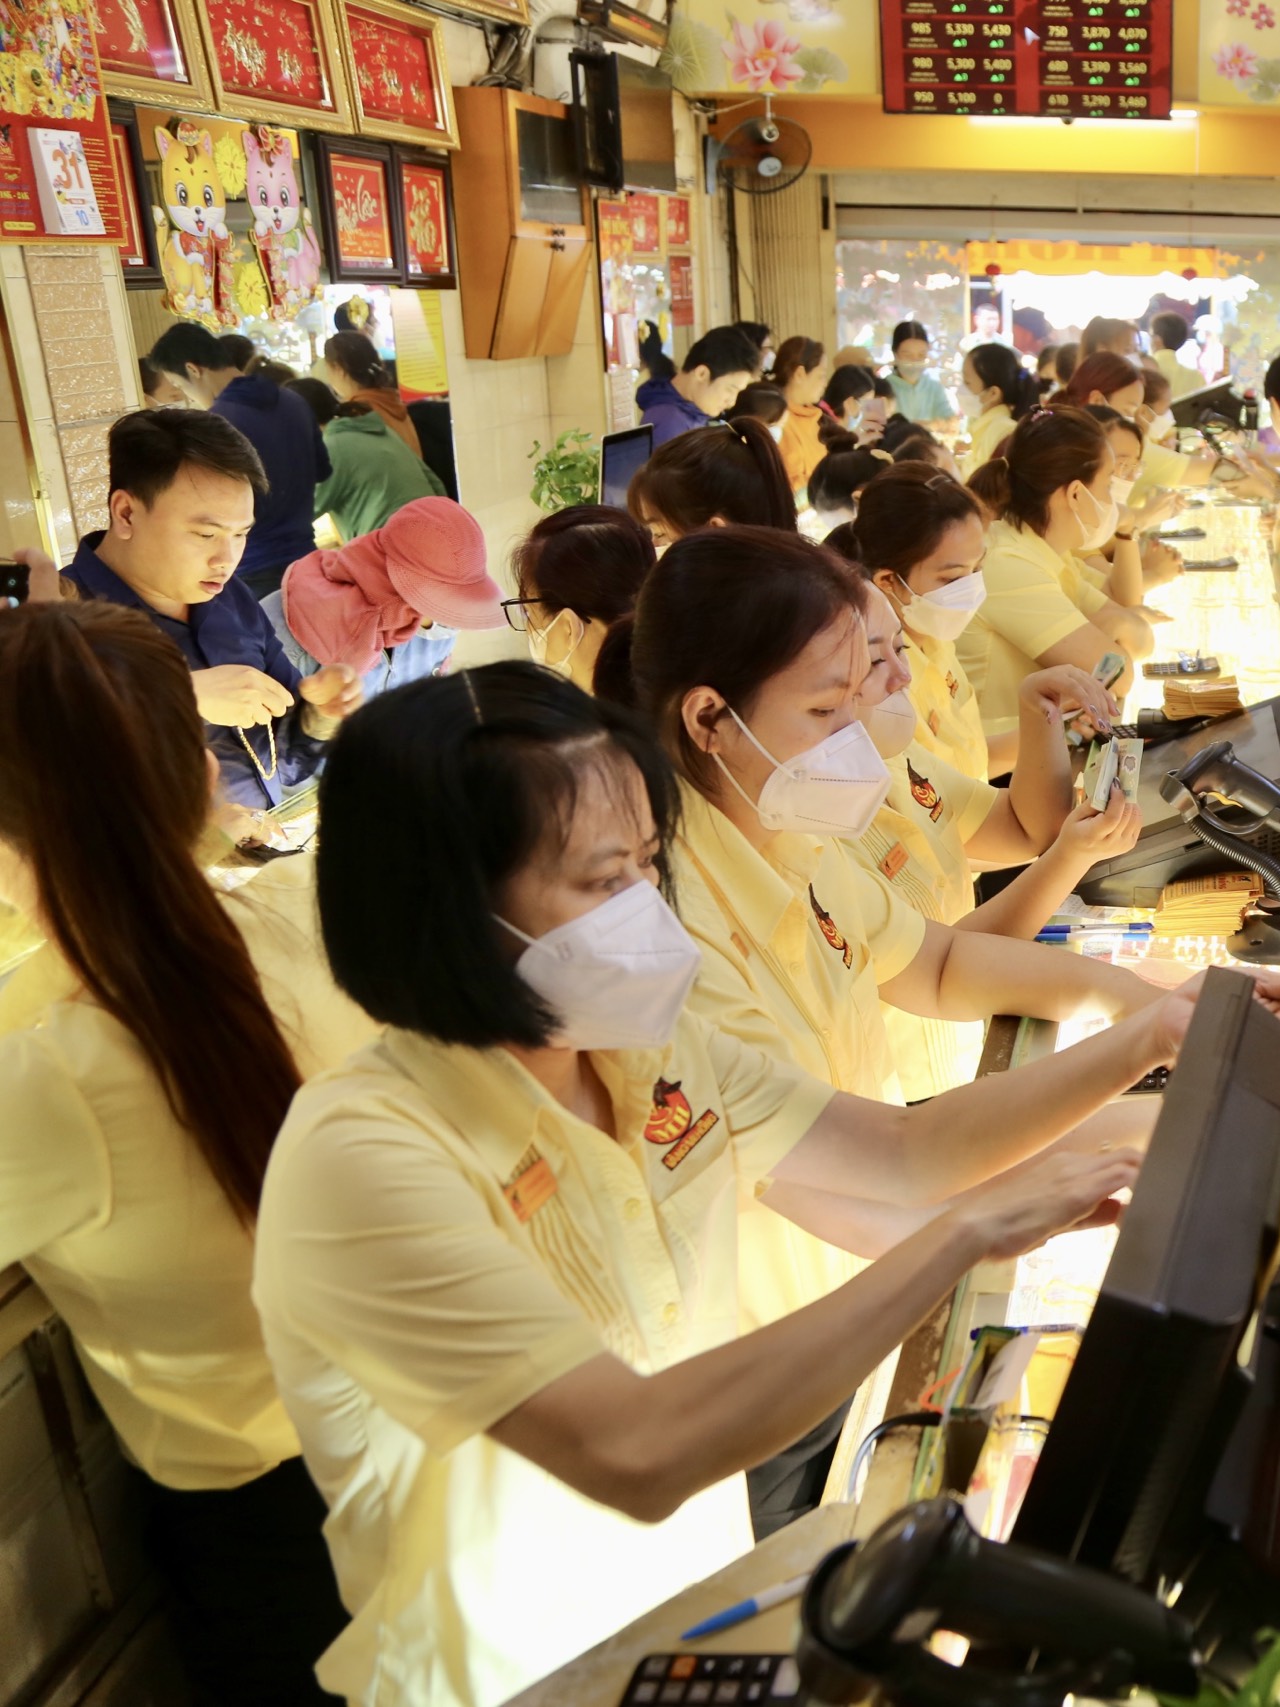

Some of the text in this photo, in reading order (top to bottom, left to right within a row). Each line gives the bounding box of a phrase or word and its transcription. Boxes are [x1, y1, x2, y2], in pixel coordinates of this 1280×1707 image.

[911, 22, 1012, 37] 985 5,330 5,430
[1048, 25, 1068, 38] 750
[912, 57, 933, 69] 980
[914, 91, 1003, 105] 950 5,100 0
[52, 148, 85, 189] 31
[76, 210, 90, 226] 10
